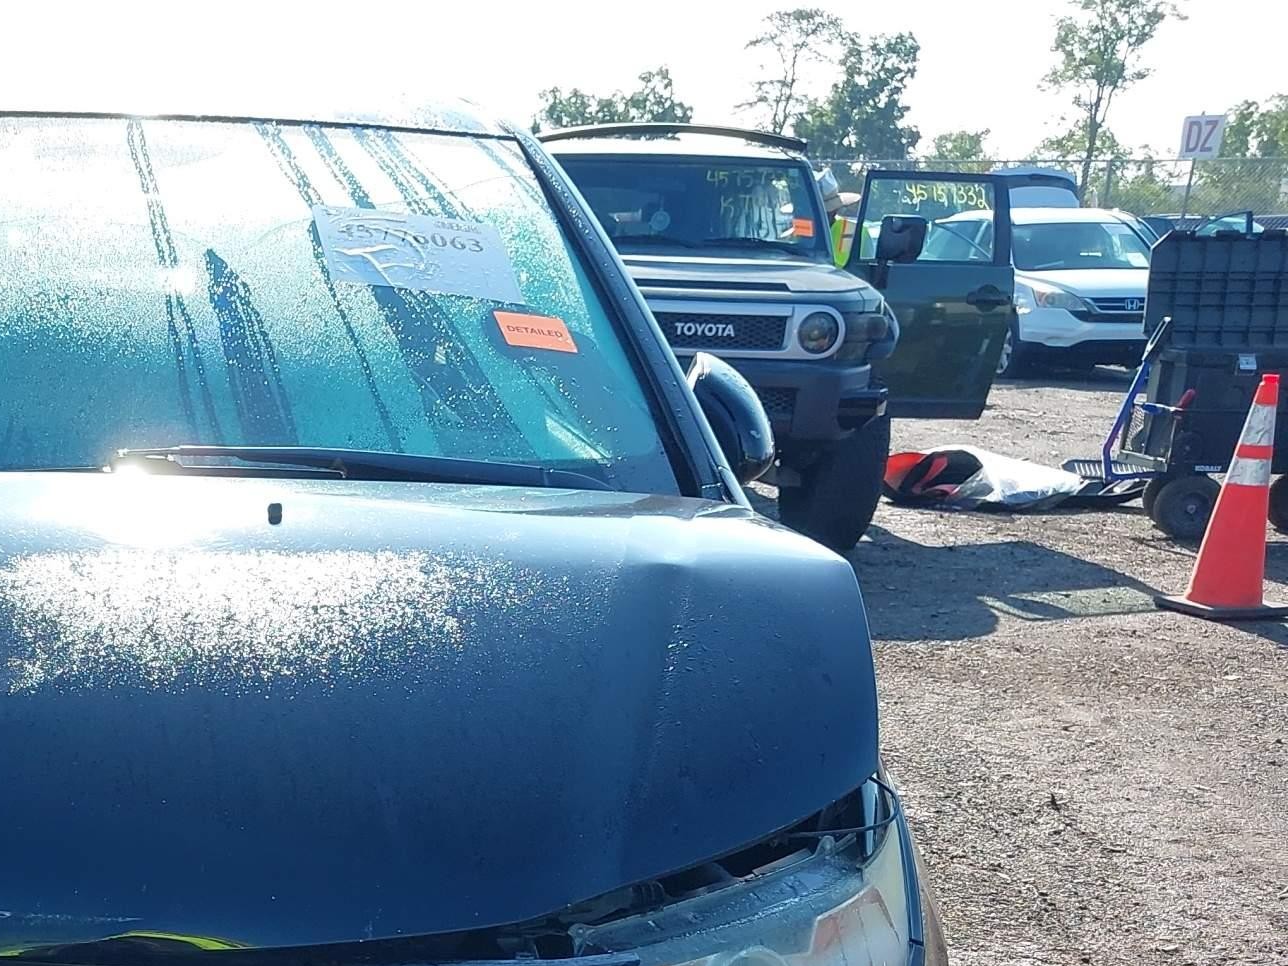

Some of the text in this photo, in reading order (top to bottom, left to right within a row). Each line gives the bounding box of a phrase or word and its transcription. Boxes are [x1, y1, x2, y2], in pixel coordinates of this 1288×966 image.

[1184, 119, 1220, 153] DZ
[506, 324, 564, 339] DETAILED
[674, 322, 736, 338] TOYOTA
